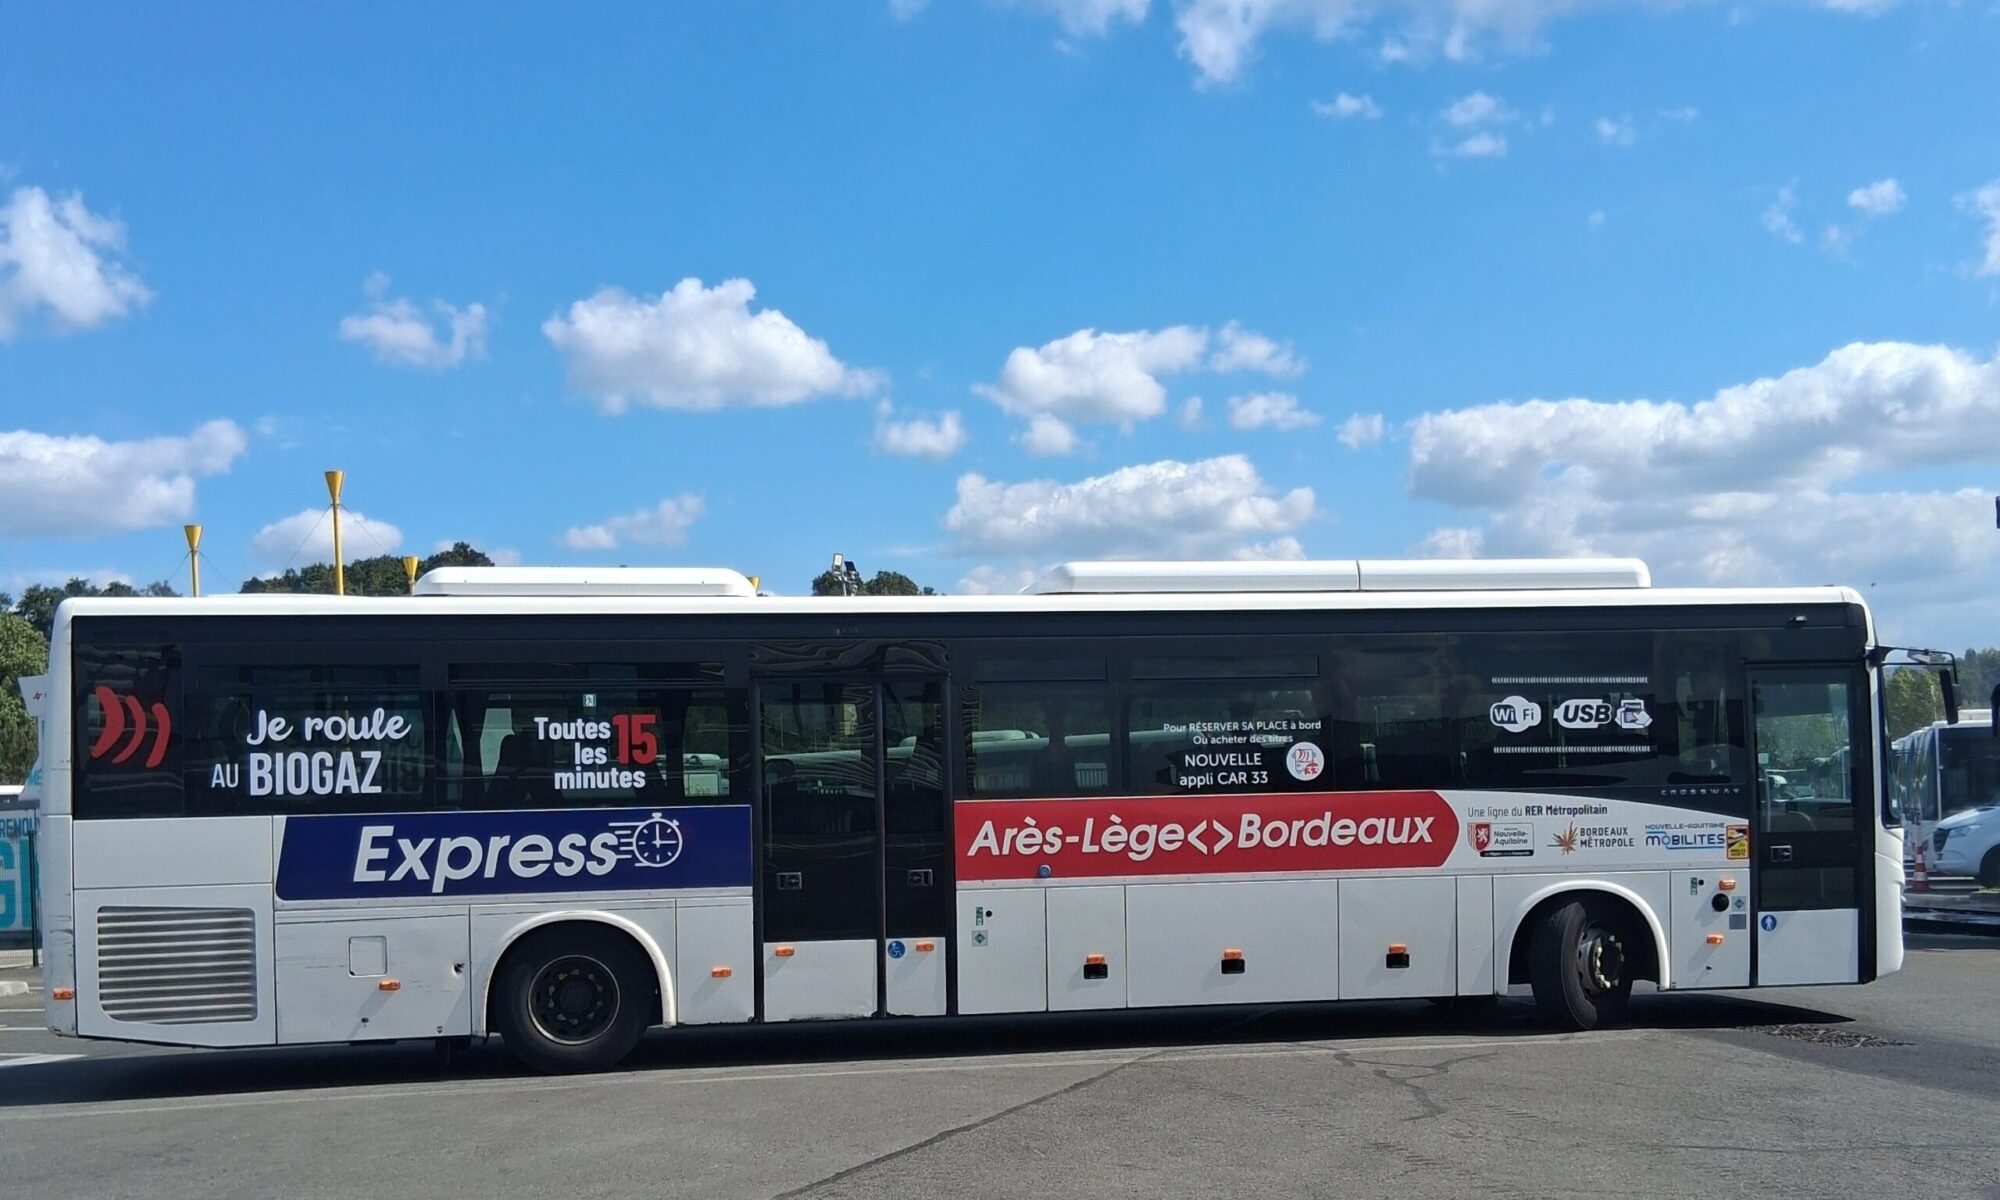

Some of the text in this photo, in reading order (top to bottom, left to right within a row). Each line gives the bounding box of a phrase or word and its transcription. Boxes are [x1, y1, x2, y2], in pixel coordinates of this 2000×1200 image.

[1563, 704, 1611, 723] USB
[247, 708, 412, 745] Je roule
[1164, 723, 1186, 732] Pour
[1189, 721, 1239, 732] RÉSERVER
[1242, 721, 1254, 731] SA
[1256, 721, 1288, 731] PLACE
[1299, 720, 1321, 730] bord
[535, 714, 657, 765] Toutes 15
[1210, 735, 1247, 744] acheter
[1250, 733, 1266, 743] des
[1268, 734, 1293, 743] titres
[575, 742, 607, 765] les
[1185, 753, 1262, 767] NOUVELLE
[211, 751, 382, 796] AU BIOGAZ
[554, 766, 646, 789] minutes
[1179, 771, 1268, 788] appli CAR 33
[1661, 788, 1739, 796] CROSSWAY
[1468, 803, 1608, 819] Une ligne du RER Métropolitain
[1580, 827, 1628, 836] BORDEAUX
[1580, 837, 1635, 848] MÉTROPOLE
[353, 826, 618, 893] Express
